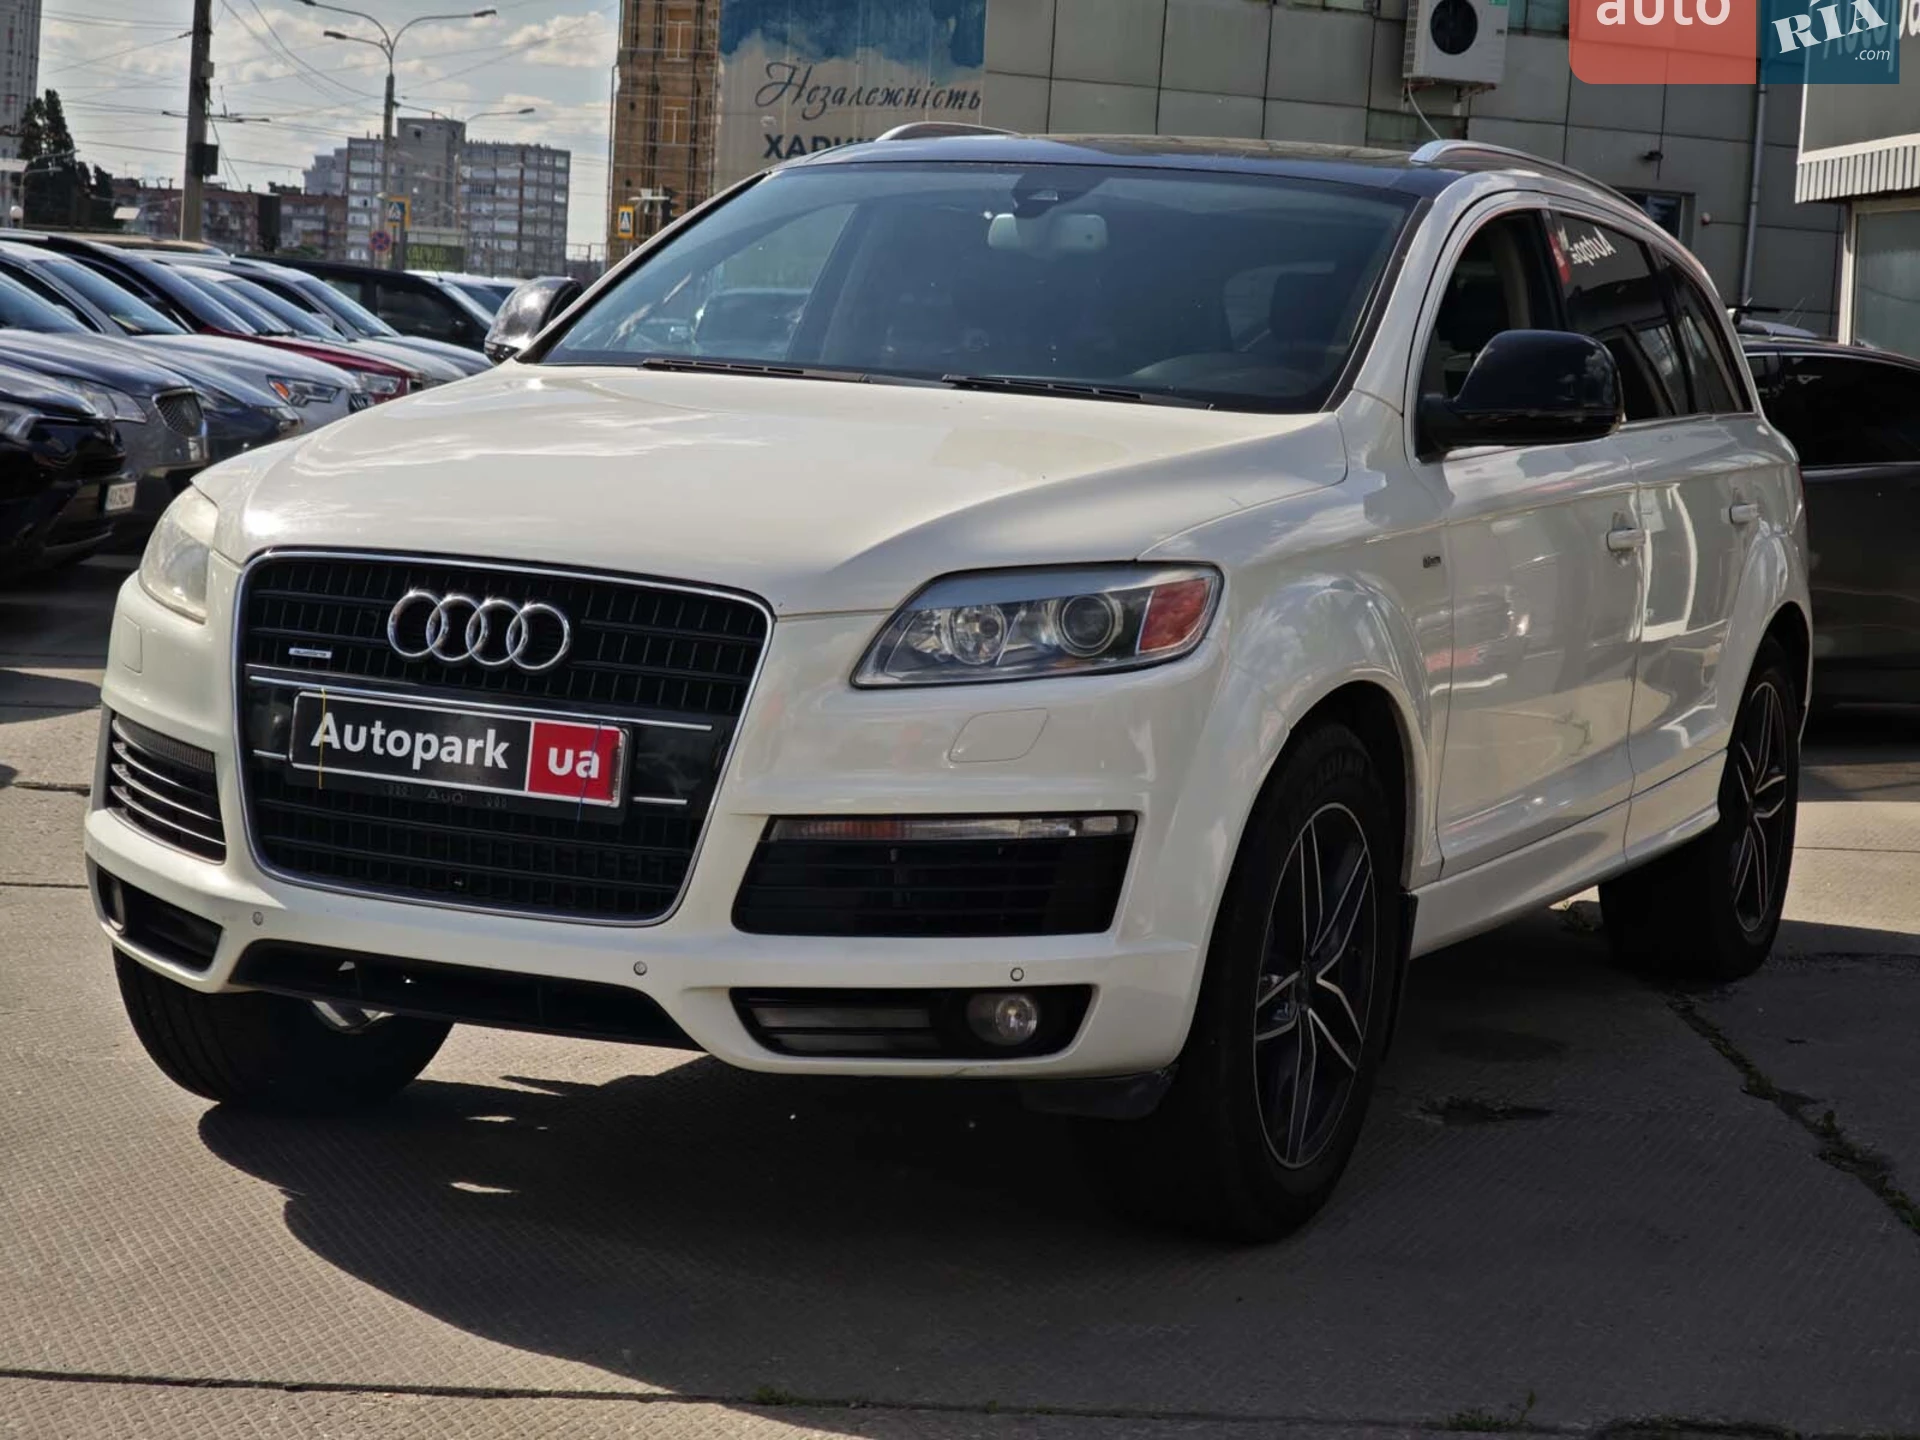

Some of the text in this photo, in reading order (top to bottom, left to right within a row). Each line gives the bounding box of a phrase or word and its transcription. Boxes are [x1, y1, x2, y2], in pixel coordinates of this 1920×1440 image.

[755, 61, 982, 120] Незалежність
[310, 712, 600, 779] Autopark ua
